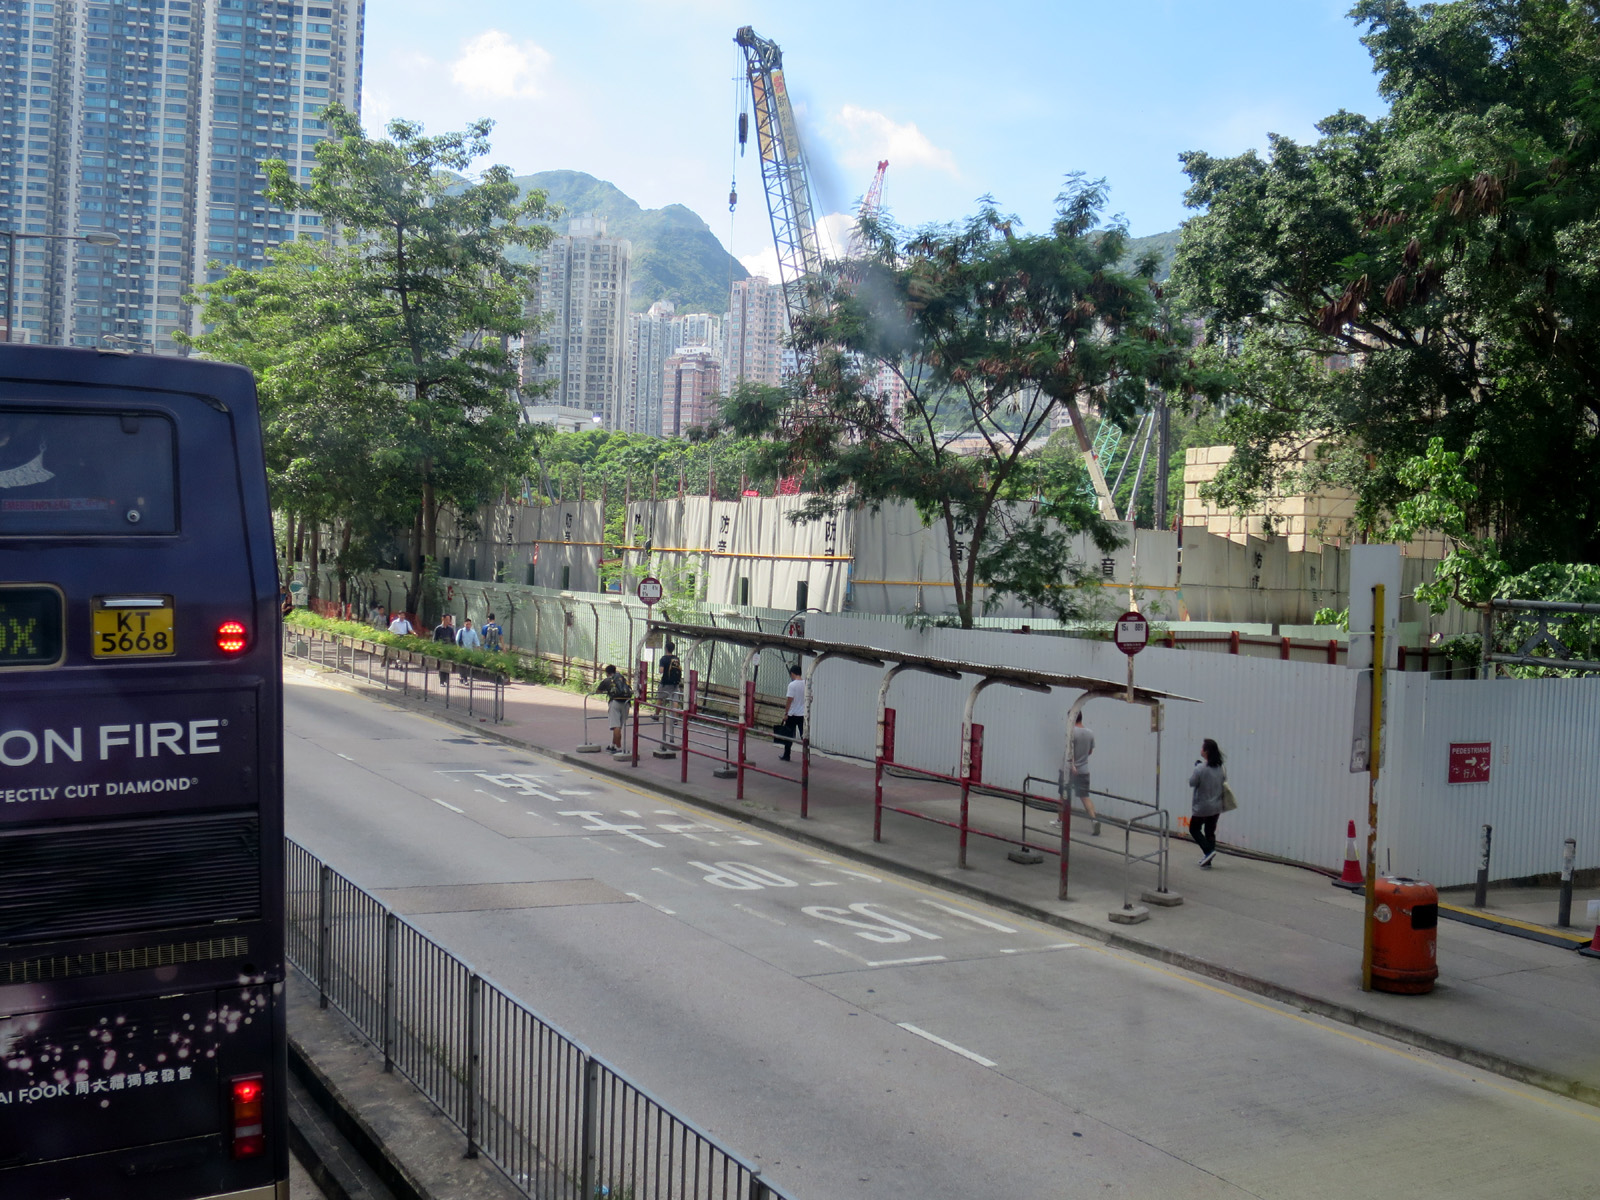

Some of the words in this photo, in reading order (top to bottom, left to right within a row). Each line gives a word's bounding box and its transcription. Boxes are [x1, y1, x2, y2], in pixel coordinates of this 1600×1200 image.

[117, 612, 150, 632] KT
[101, 632, 168, 652] 5668
[0, 727, 82, 767] ON
[64, 783, 100, 799] CUT
[19, 1085, 70, 1102] FOOK
